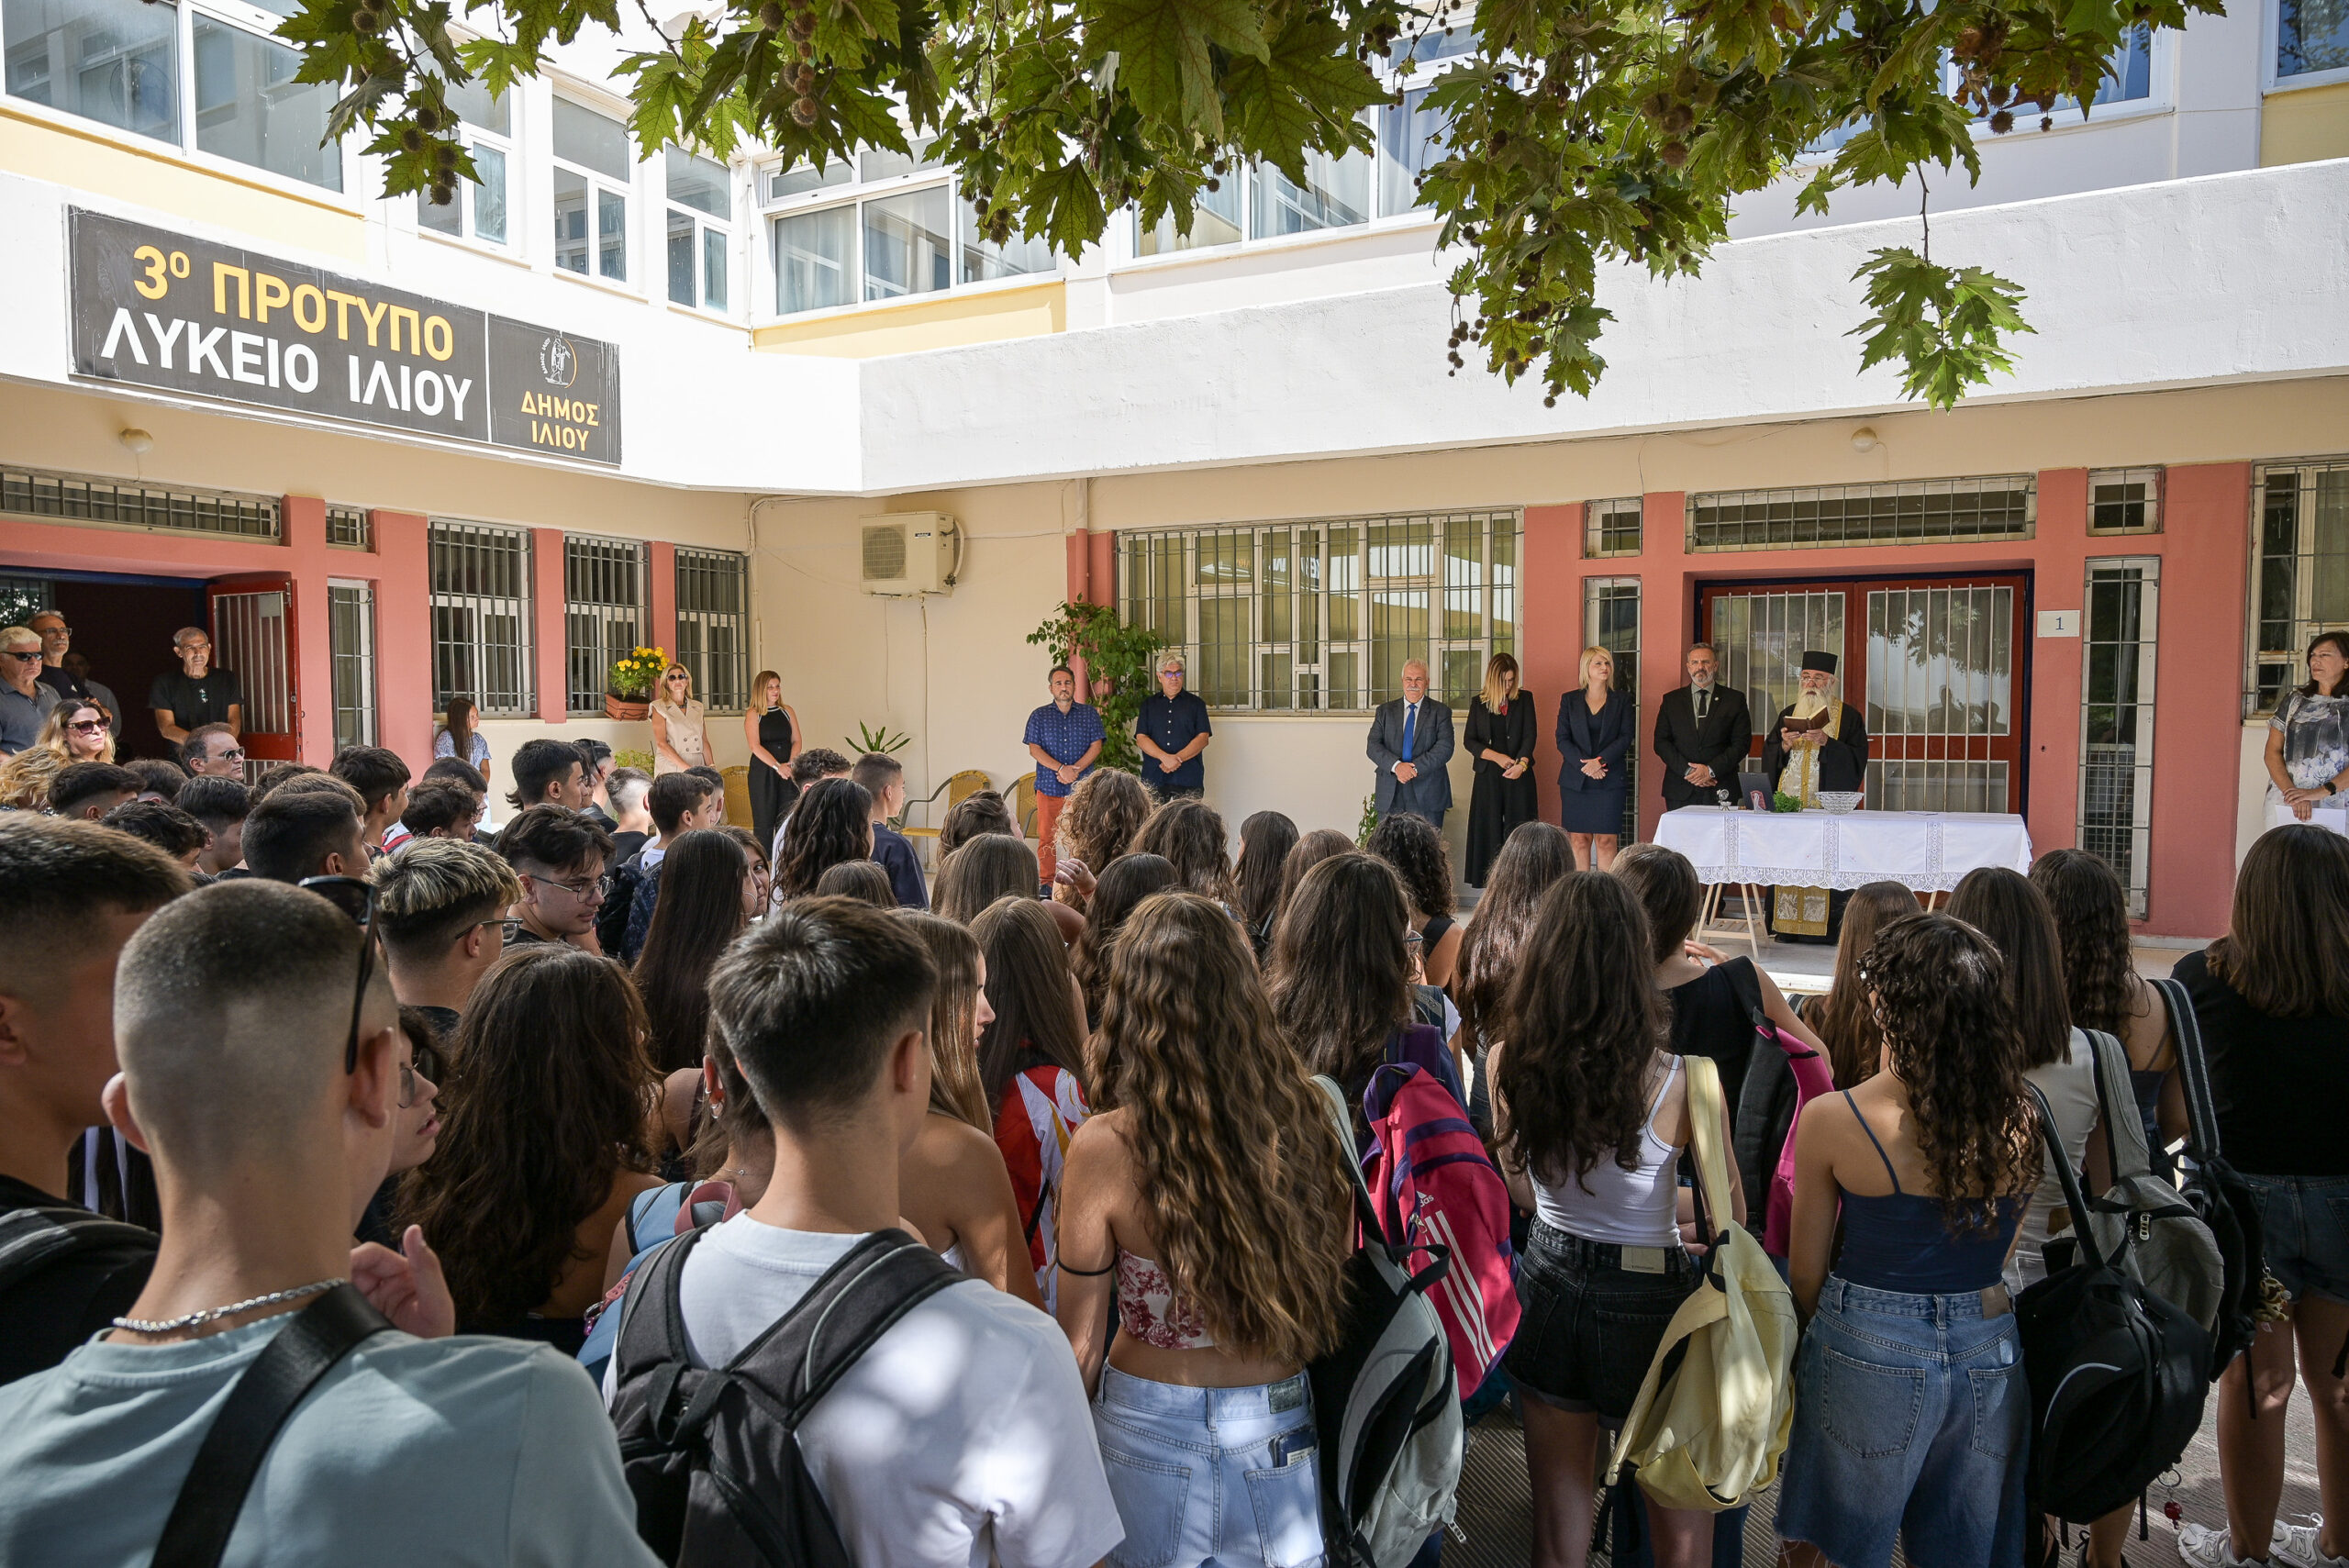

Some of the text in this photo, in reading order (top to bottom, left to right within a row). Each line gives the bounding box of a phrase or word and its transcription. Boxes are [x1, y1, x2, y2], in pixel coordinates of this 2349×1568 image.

[213, 261, 453, 361] ΠΡΟΤΥΠΟ
[100, 306, 473, 421] ΛΥΚΕΙΟ ΙΛΙΟΥ
[520, 390, 599, 427] ΔΗΜΟΣ
[531, 420, 589, 451] ΙΛΙΟΥ
[2055, 617, 2065, 630] 1
